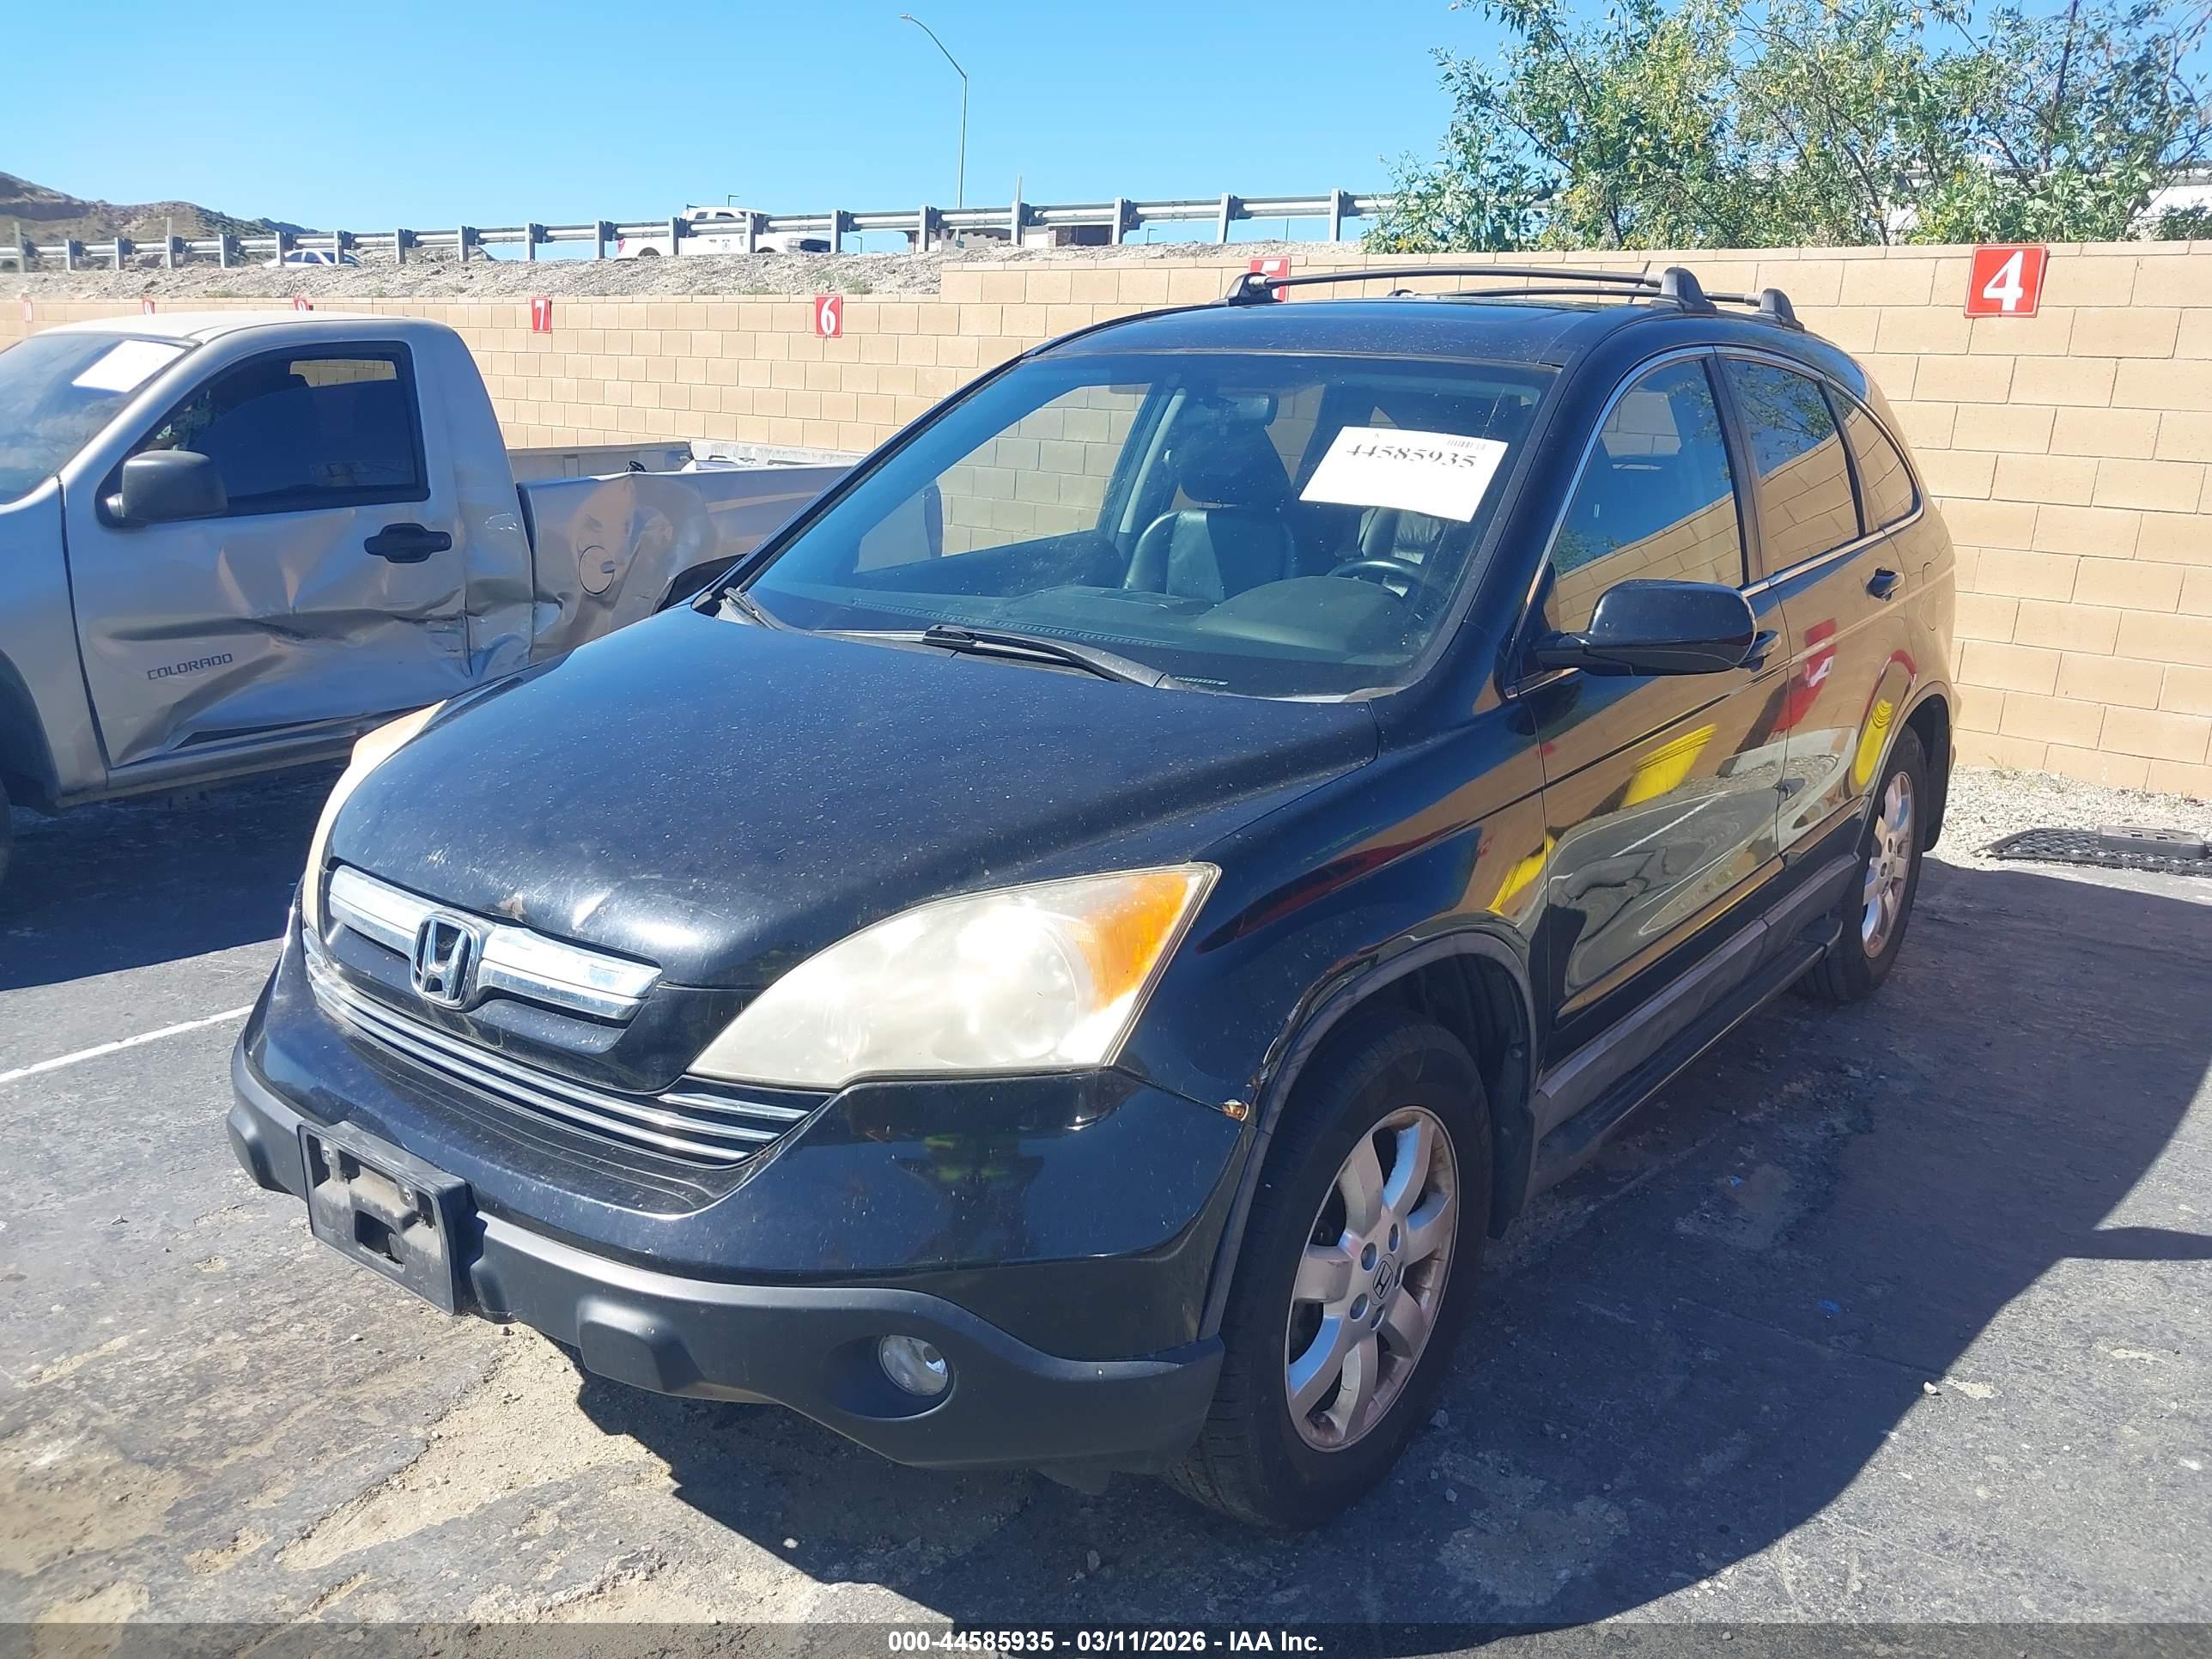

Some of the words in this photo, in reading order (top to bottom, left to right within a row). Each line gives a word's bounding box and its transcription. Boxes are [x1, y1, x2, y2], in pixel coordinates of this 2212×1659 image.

[1982, 250, 2024, 311] 4
[534, 299, 545, 331] 7
[820, 296, 837, 335] 6
[1346, 443, 1477, 468] 44585935
[147, 653, 234, 680] COLORADO
